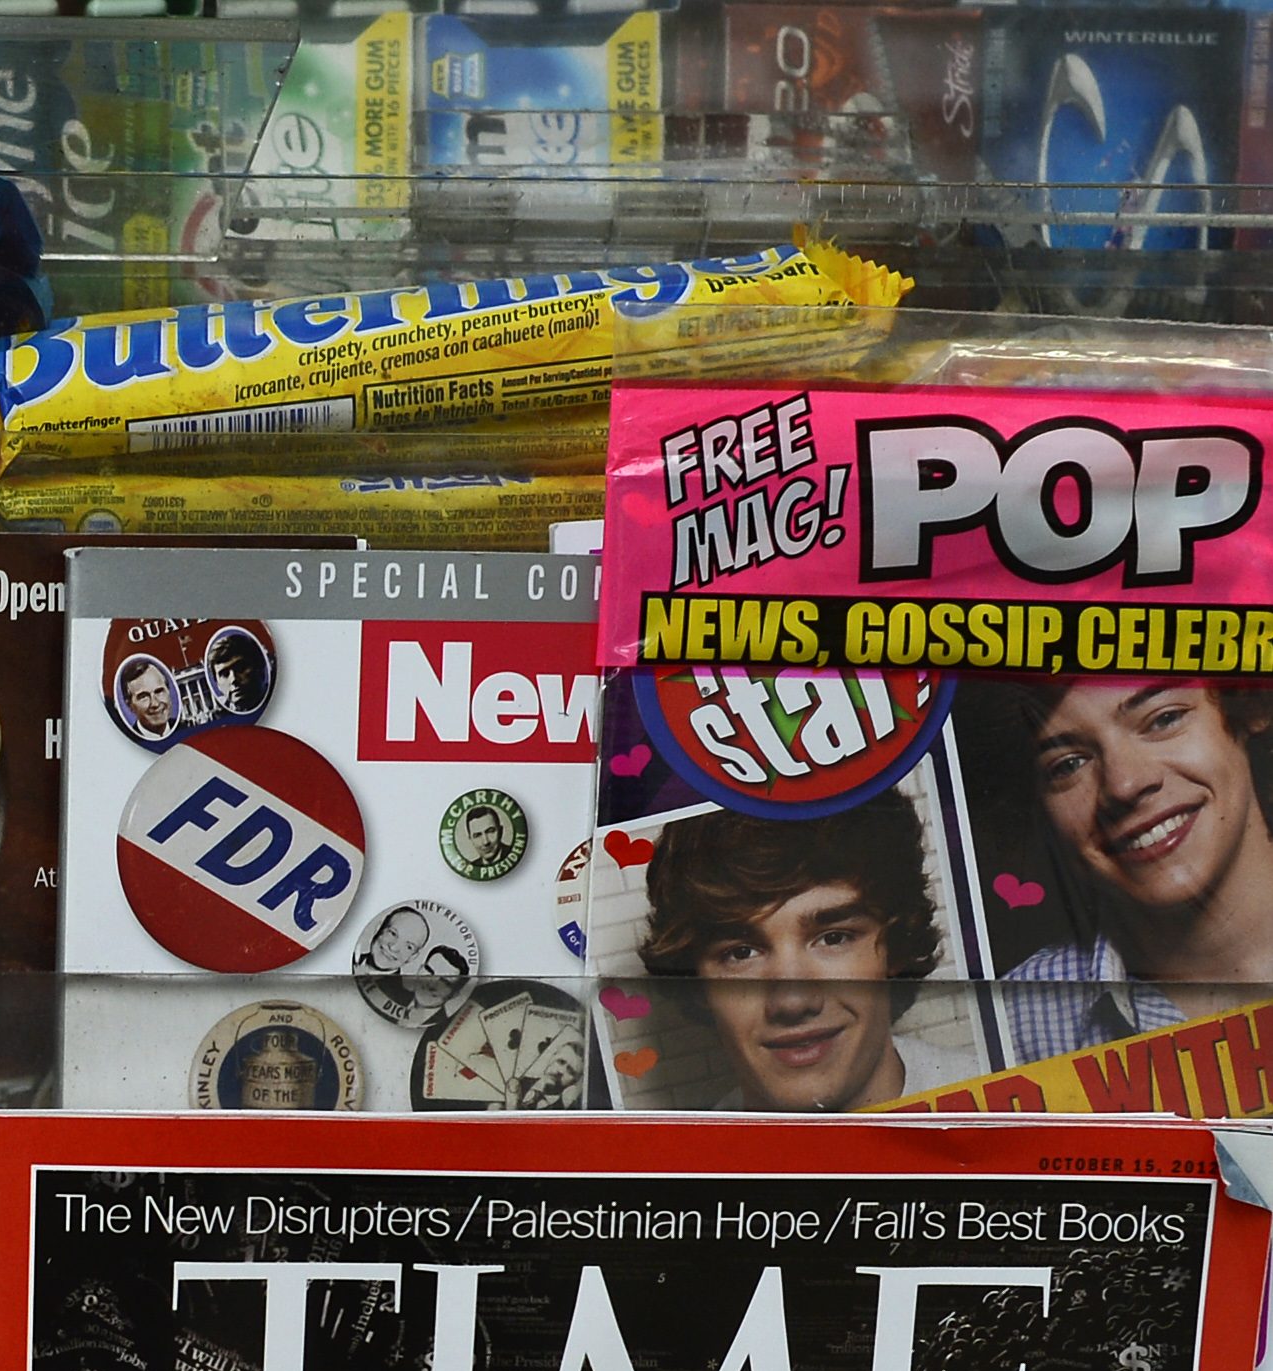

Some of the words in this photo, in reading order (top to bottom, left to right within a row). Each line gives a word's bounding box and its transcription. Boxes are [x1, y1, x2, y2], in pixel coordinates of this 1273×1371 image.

[1064, 29, 1220, 46] WINTERBLUE
[298, 336, 364, 367] crispety,
[372, 319, 456, 356] crunchety,
[309, 358, 379, 388] crujiente,
[381, 344, 440, 378] cremosa
[445, 342, 469, 360] con
[473, 321, 546, 356] cacahuete
[663, 397, 813, 505] FREE
[673, 462, 850, 587] MAG!
[856, 415, 1263, 587] POP
[285, 562, 489, 599] SPECIAL
[644, 597, 828, 667] NEWS,
[844, 600, 1063, 674] GOSSIP,
[147, 776, 352, 931] FDR
[55, 1193, 131, 1236] The
[144, 1195, 235, 1236] New
[957, 1204, 1046, 1242] Best
[1058, 1203, 1185, 1245] Books
